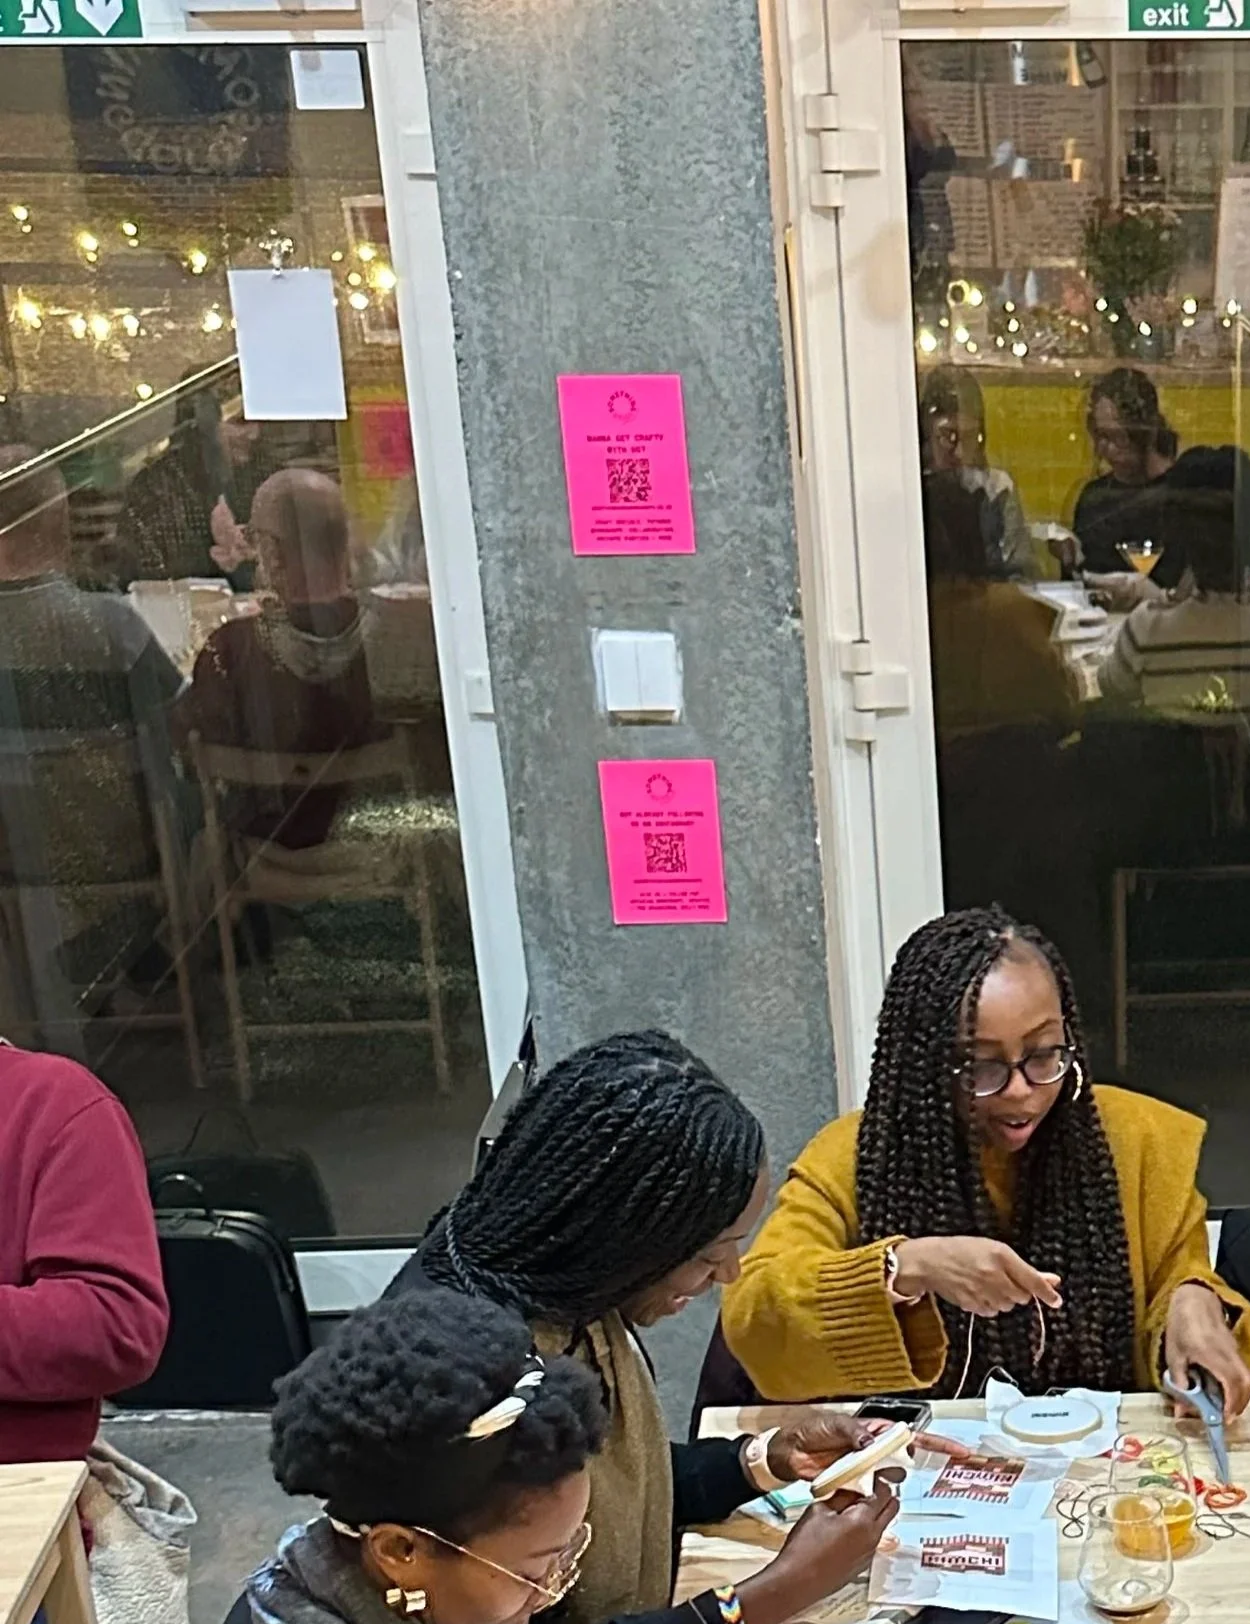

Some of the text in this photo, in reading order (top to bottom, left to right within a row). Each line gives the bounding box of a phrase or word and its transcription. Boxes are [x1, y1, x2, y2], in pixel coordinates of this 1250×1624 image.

[1143, 2, 1189, 26] exit
[945, 1469, 1013, 1483] KIMCHI
[928, 1556, 1000, 1566] KIMCHI
